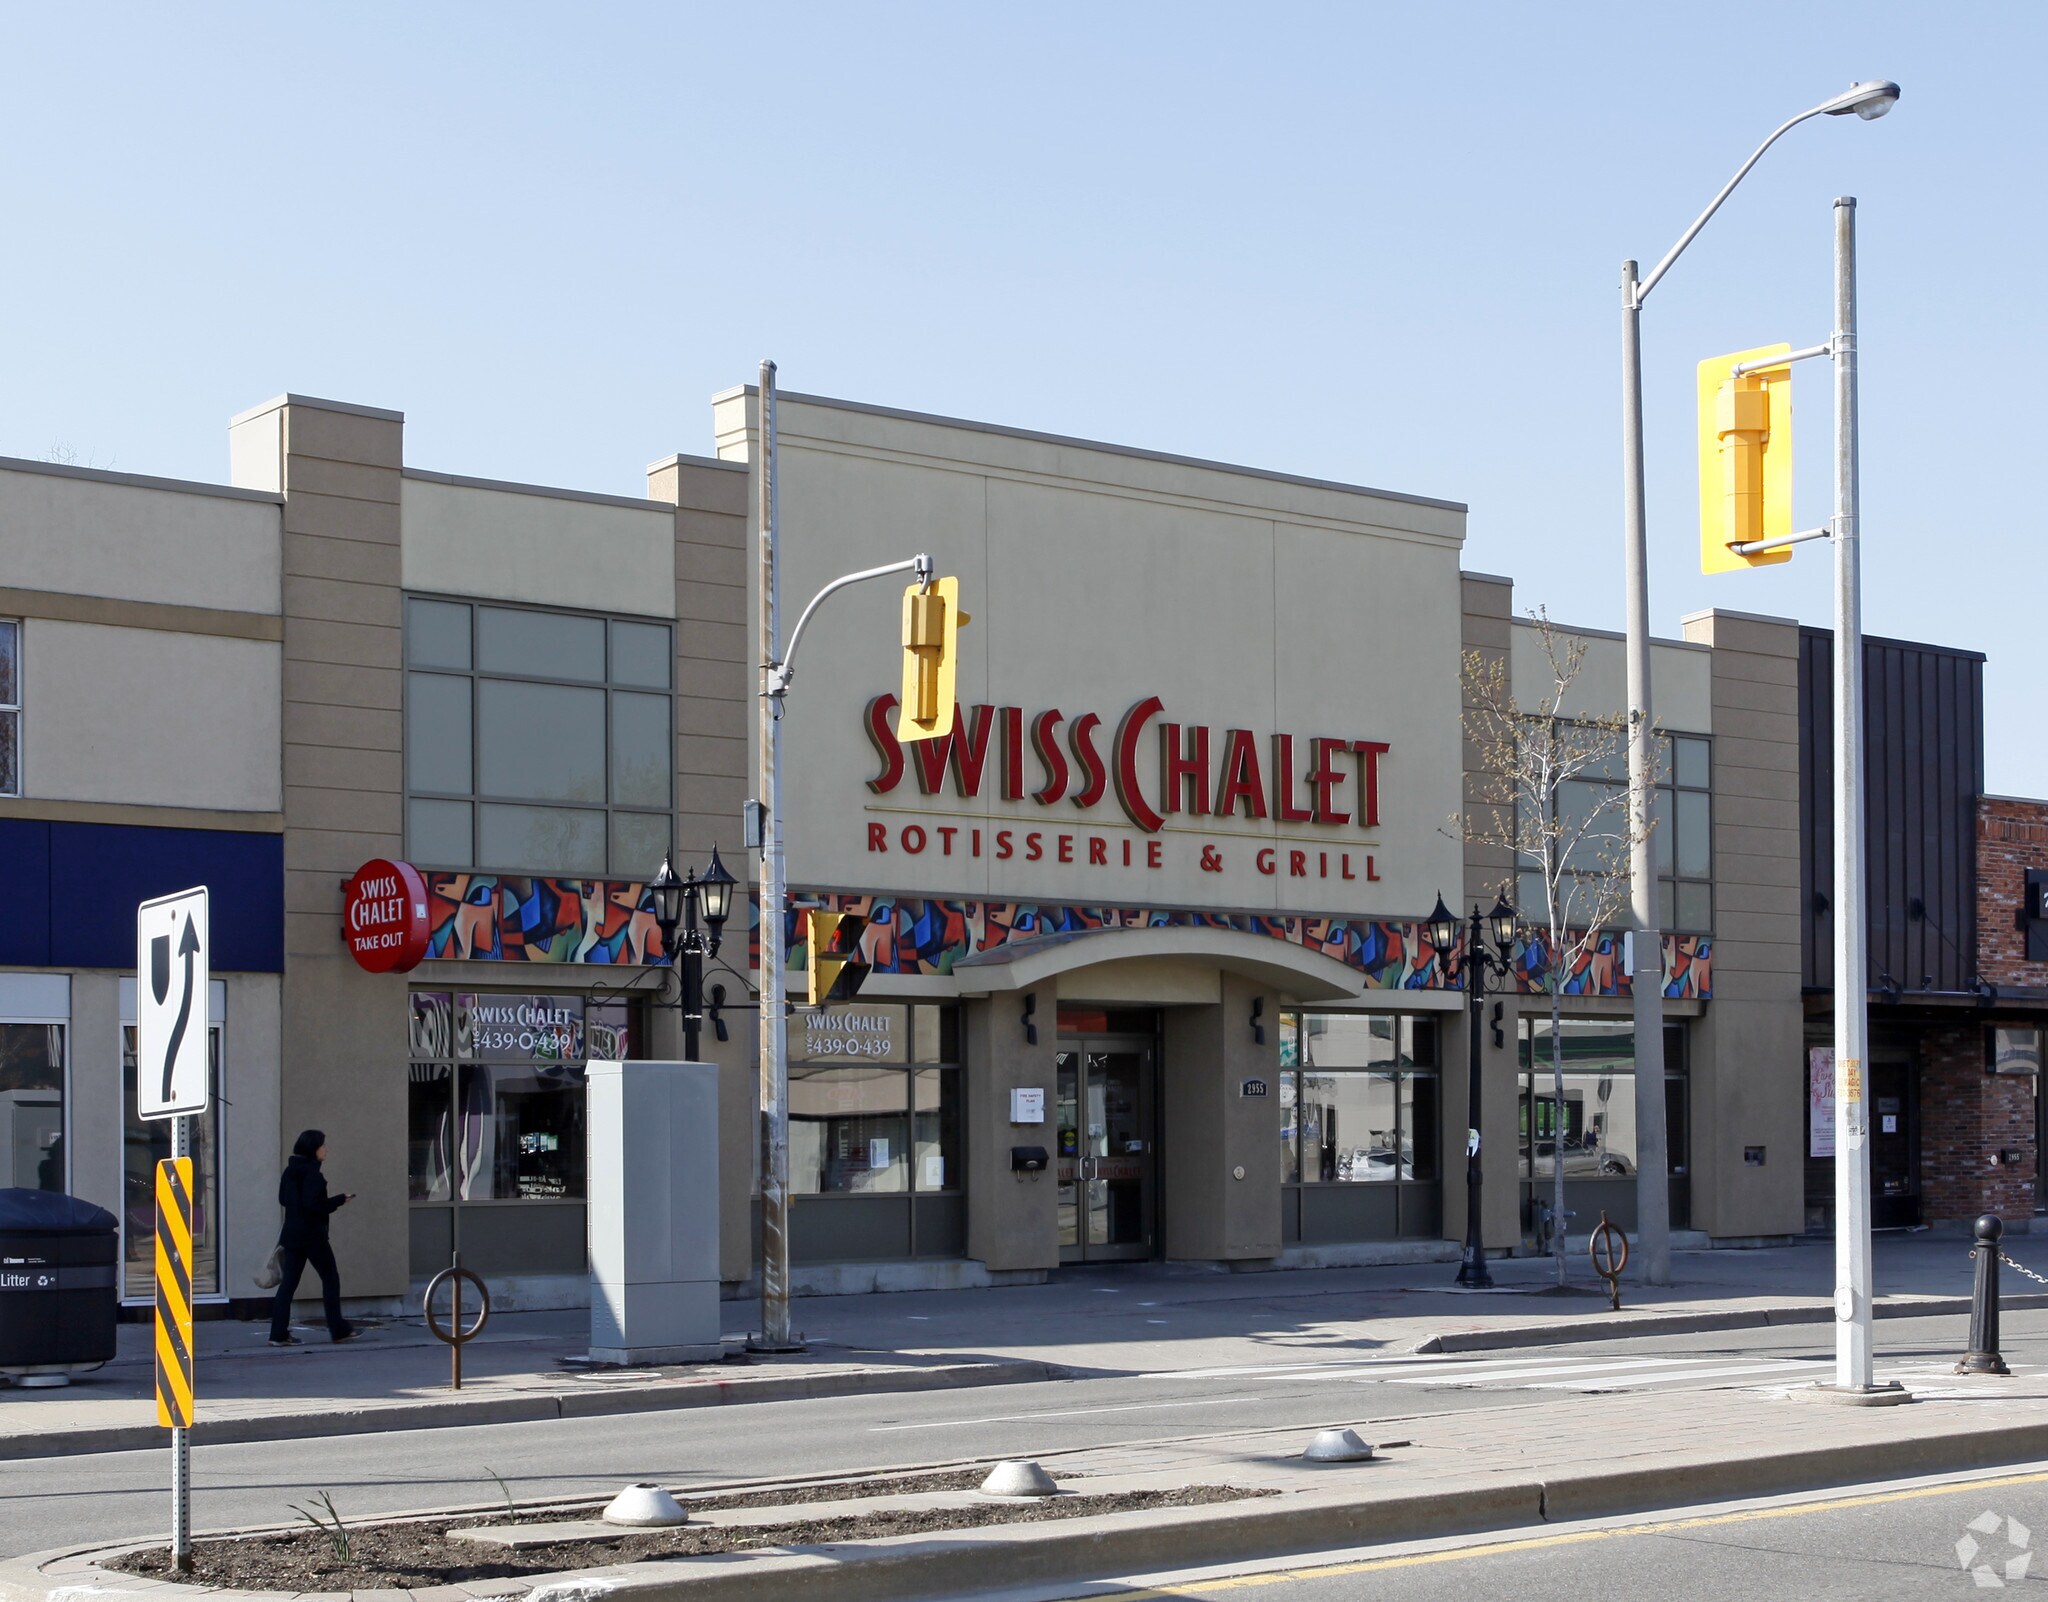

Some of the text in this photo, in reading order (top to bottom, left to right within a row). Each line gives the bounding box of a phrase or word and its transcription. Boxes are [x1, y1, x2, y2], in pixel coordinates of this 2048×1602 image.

[867, 822, 1381, 882] ROTISSERIE & GRILL
[360, 876, 397, 900] SWISS
[351, 898, 404, 931] CHALET
[354, 932, 403, 952] TAKE OUT
[1247, 1083, 1264, 1095] 2955
[1, 1273, 30, 1287] Litter
